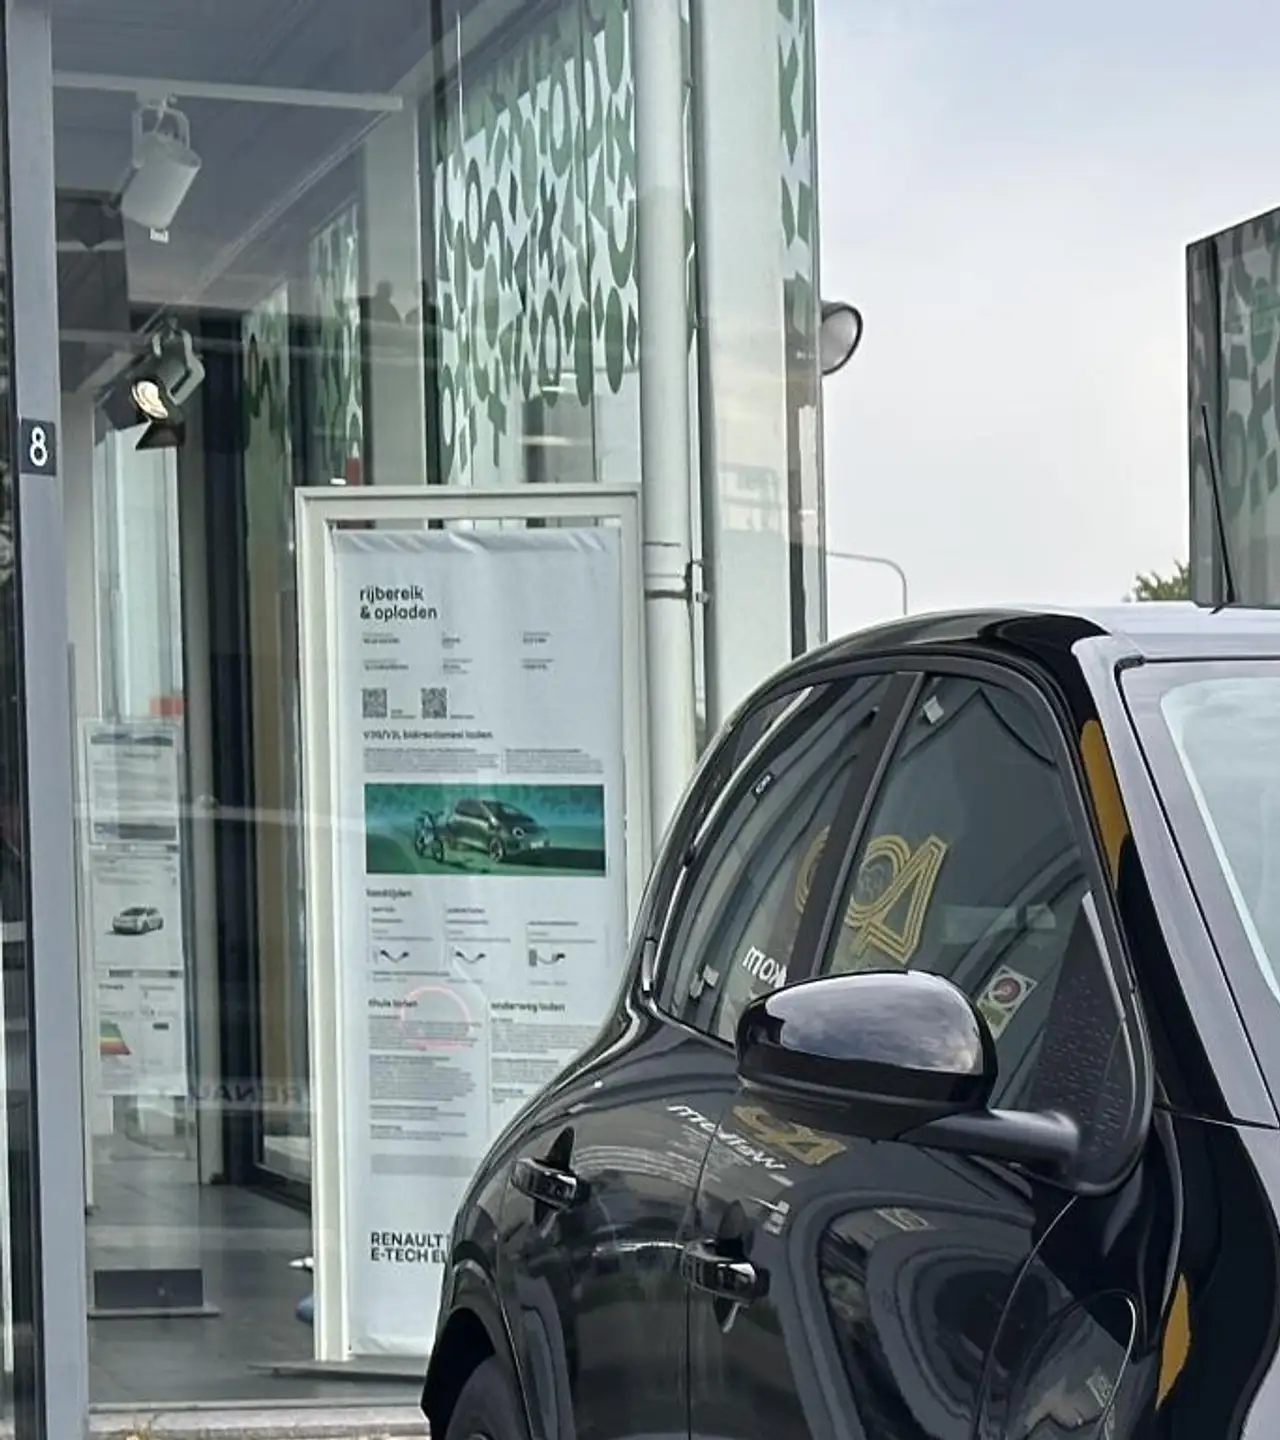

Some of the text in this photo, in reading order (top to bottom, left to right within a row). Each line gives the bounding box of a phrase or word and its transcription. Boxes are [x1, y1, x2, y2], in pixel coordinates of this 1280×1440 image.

[30, 426, 48, 467] 8
[359, 585, 424, 604] rijbereik
[359, 604, 438, 622] & opladen
[370, 1231, 443, 1248] RENAULT
[370, 1248, 429, 1262] E-TECH
